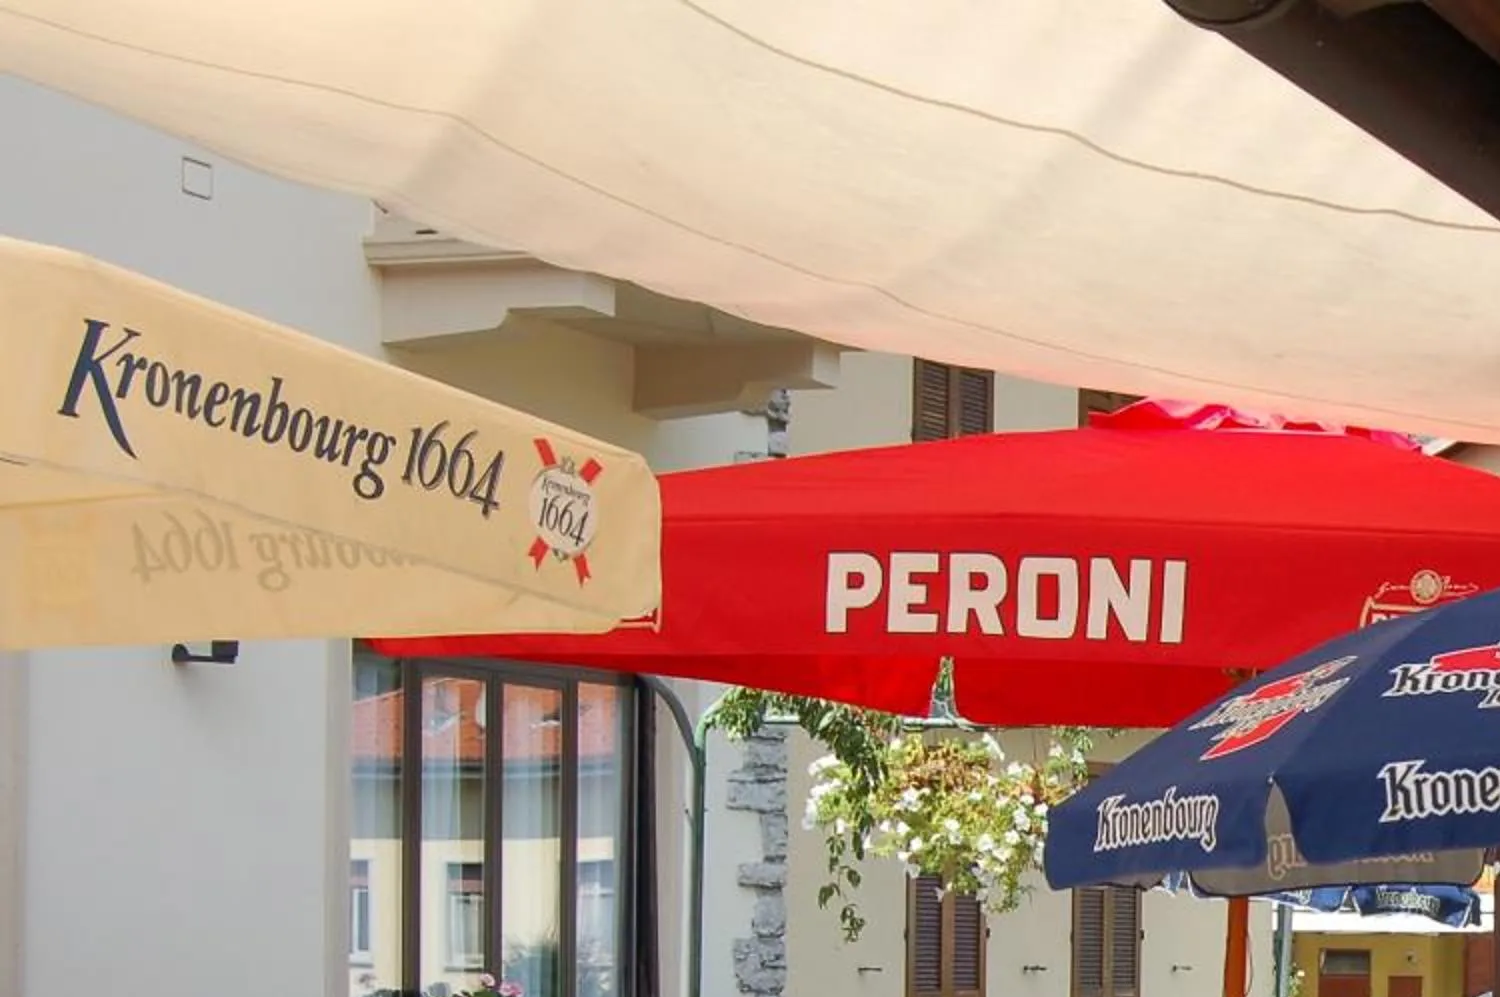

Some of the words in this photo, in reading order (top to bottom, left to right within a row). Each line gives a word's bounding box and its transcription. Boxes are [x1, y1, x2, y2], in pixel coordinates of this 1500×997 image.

[58, 318, 396, 499] Kronenbourg
[401, 420, 504, 520] 1664
[539, 496, 588, 546] 1664
[825, 551, 1187, 643] PERONI
[1094, 785, 1219, 852] Kronenbourg
